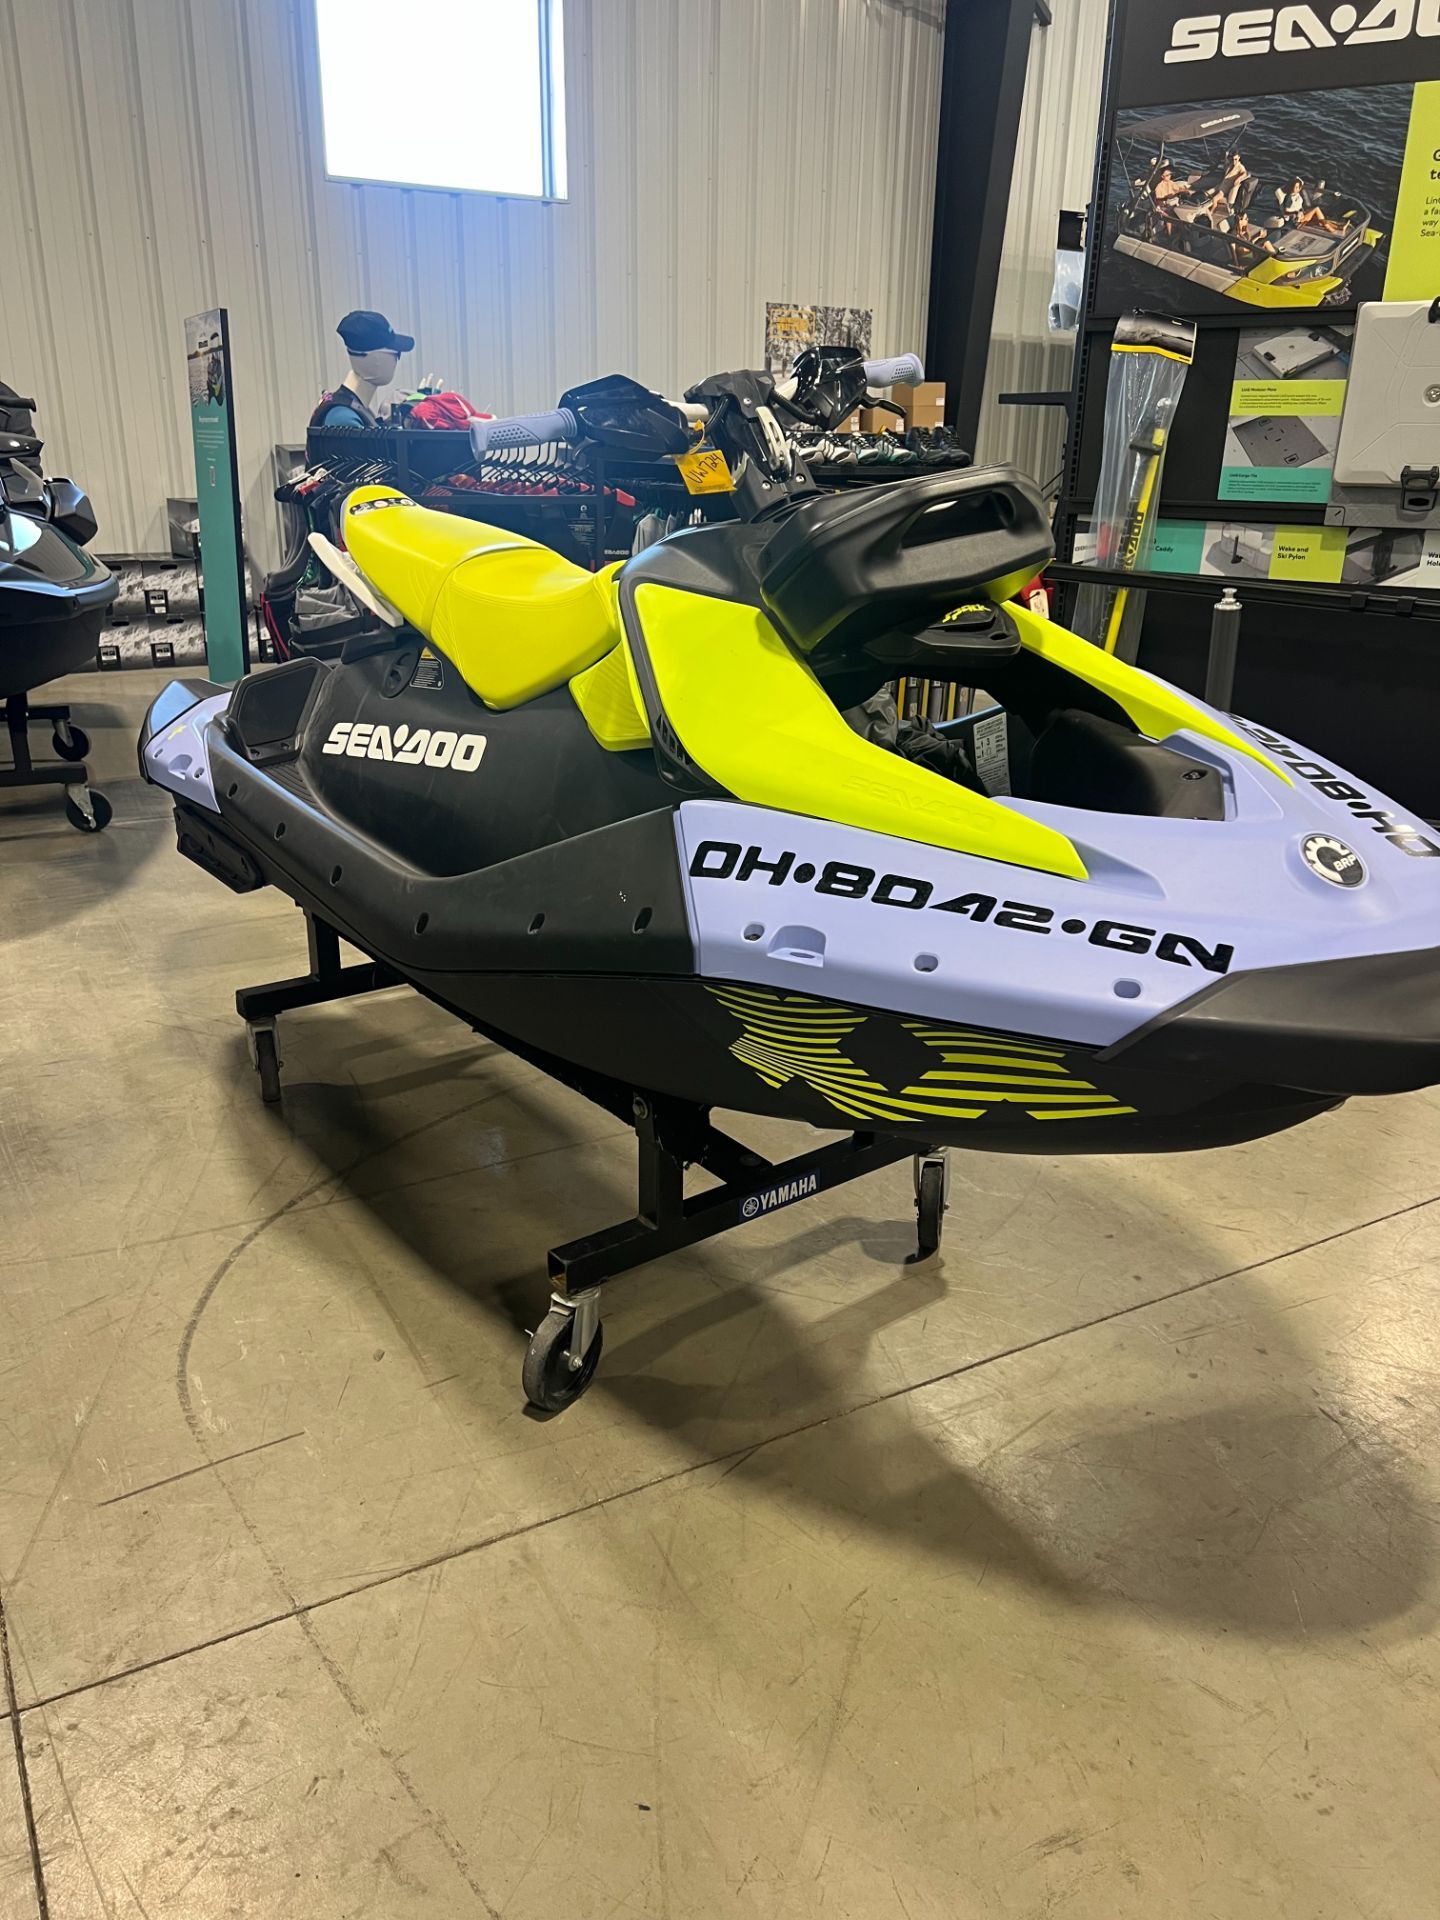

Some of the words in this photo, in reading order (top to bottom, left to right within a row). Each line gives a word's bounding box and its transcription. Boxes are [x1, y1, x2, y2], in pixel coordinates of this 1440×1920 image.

[1288, 553, 1306, 561] Pylon
[1333, 854, 1357, 872] BRP
[760, 1174, 817, 1211] YAMAHA
